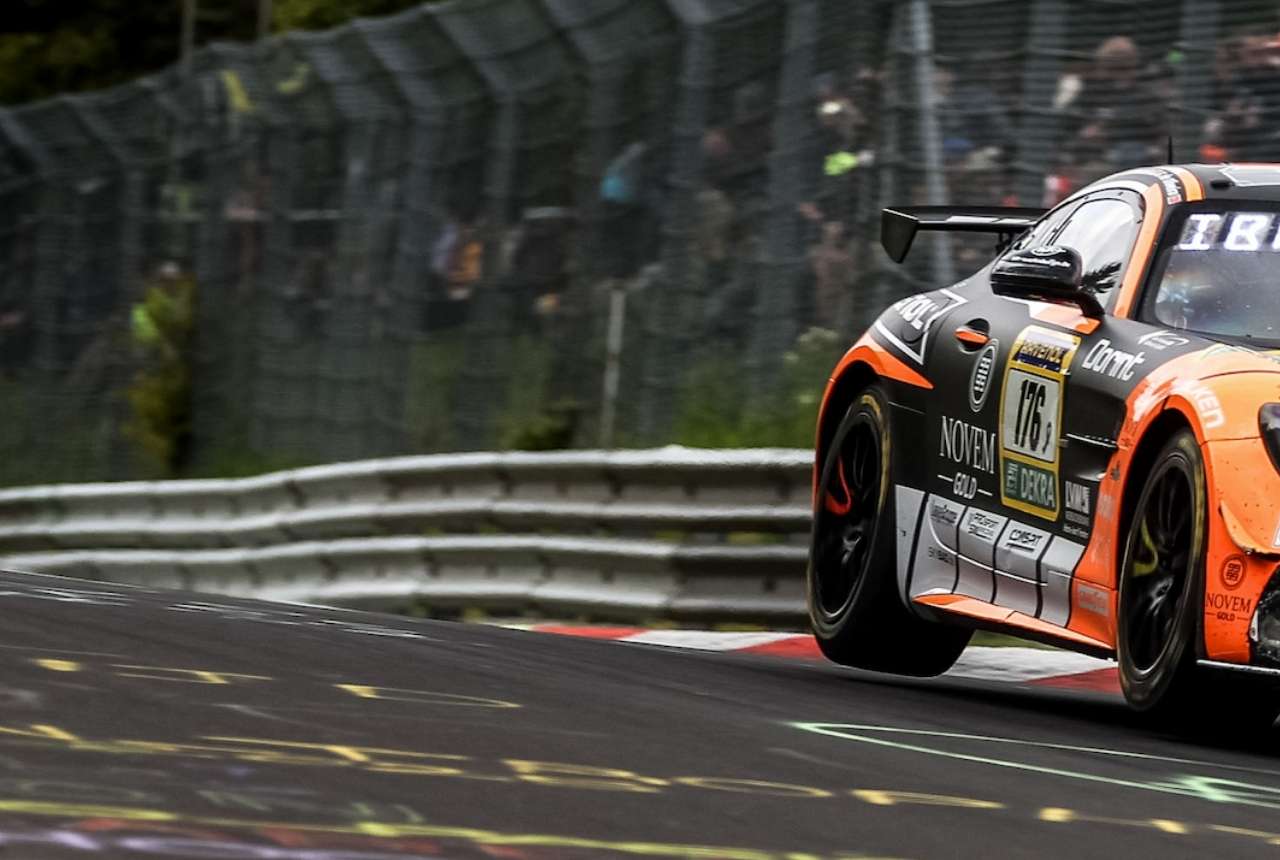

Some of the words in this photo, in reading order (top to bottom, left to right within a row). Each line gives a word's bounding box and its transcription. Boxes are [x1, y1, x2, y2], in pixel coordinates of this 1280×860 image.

[1014, 379, 1046, 451] 176
[938, 416, 996, 474] NOVEM
[952, 472, 978, 500] GOLD
[1020, 467, 1056, 508] DEKRA
[1205, 593, 1250, 613] NOVEM
[1216, 611, 1236, 622] GOLD
